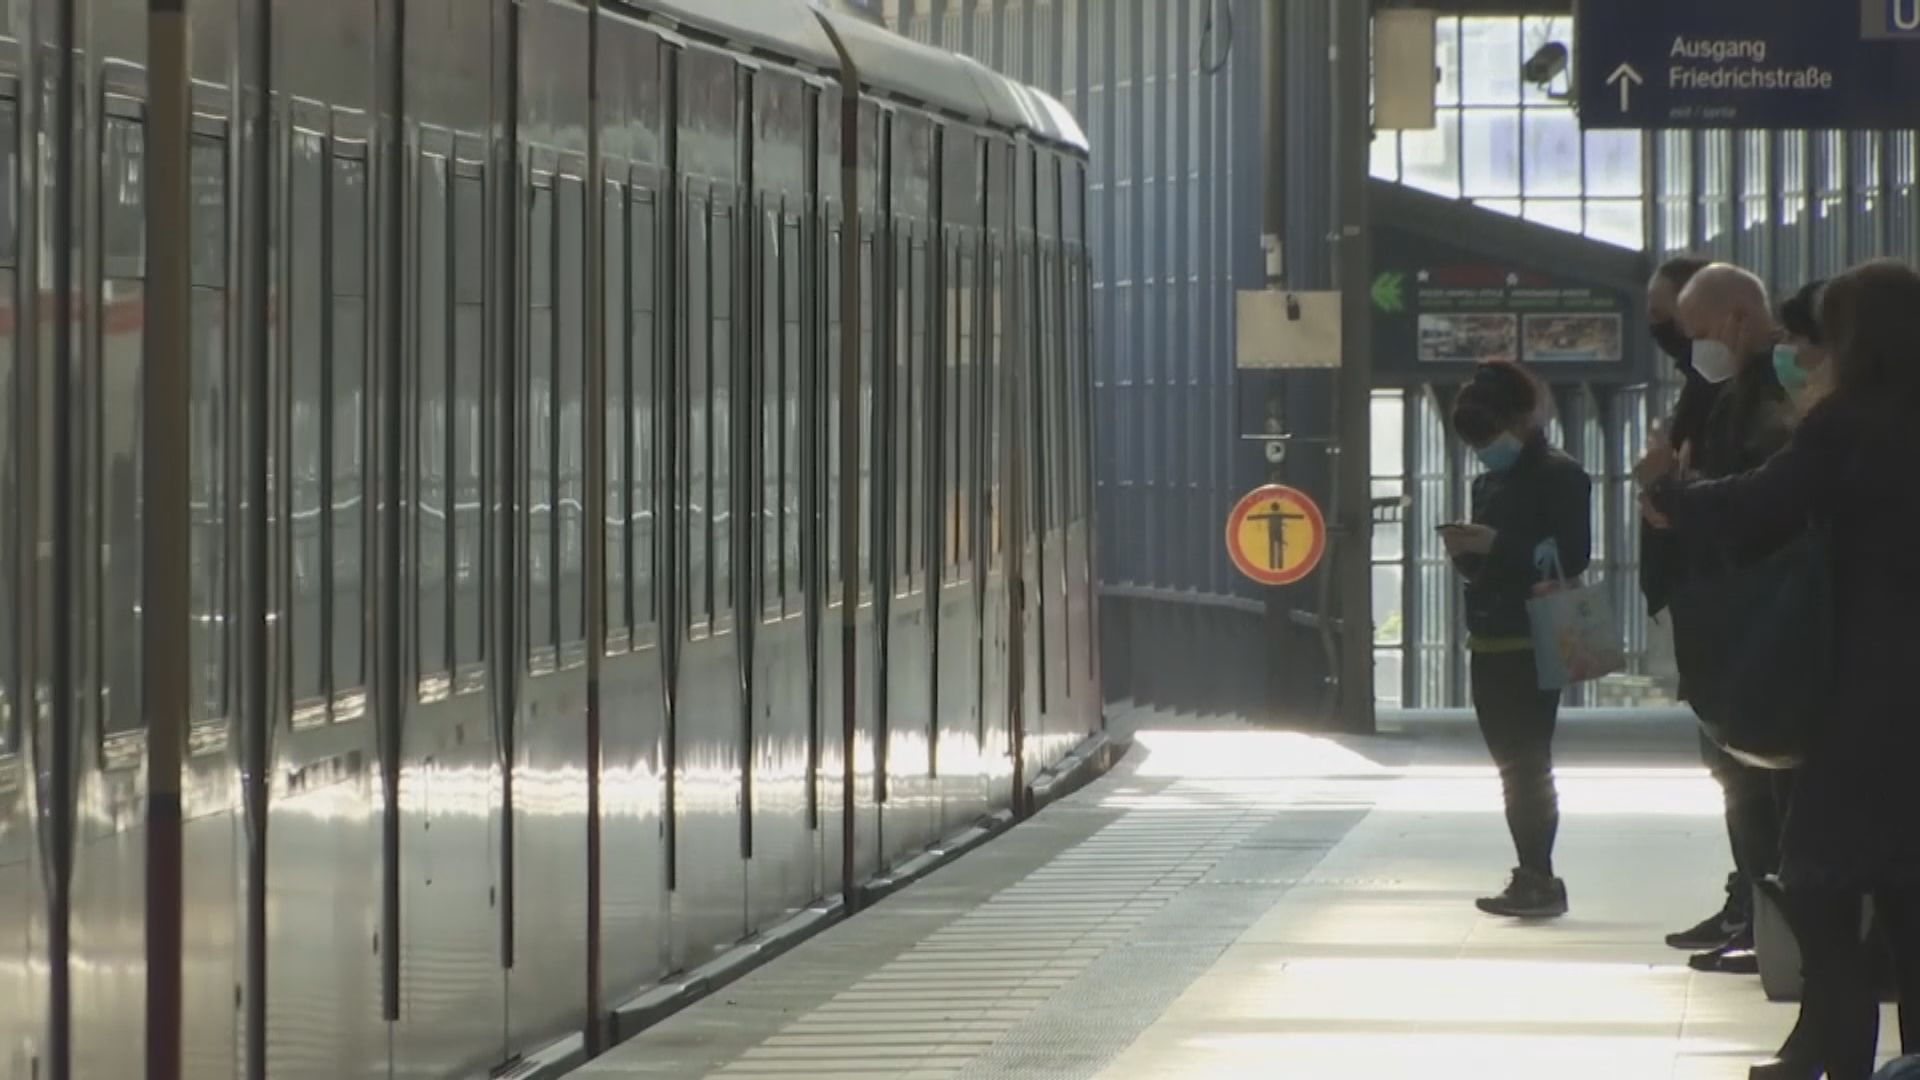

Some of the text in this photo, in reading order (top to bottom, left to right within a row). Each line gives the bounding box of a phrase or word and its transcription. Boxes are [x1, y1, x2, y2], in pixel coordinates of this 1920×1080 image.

[1893, 0, 1920, 30] U
[1670, 36, 1766, 62] Ausgang
[1669, 66, 1832, 89] Friedrichstraße
